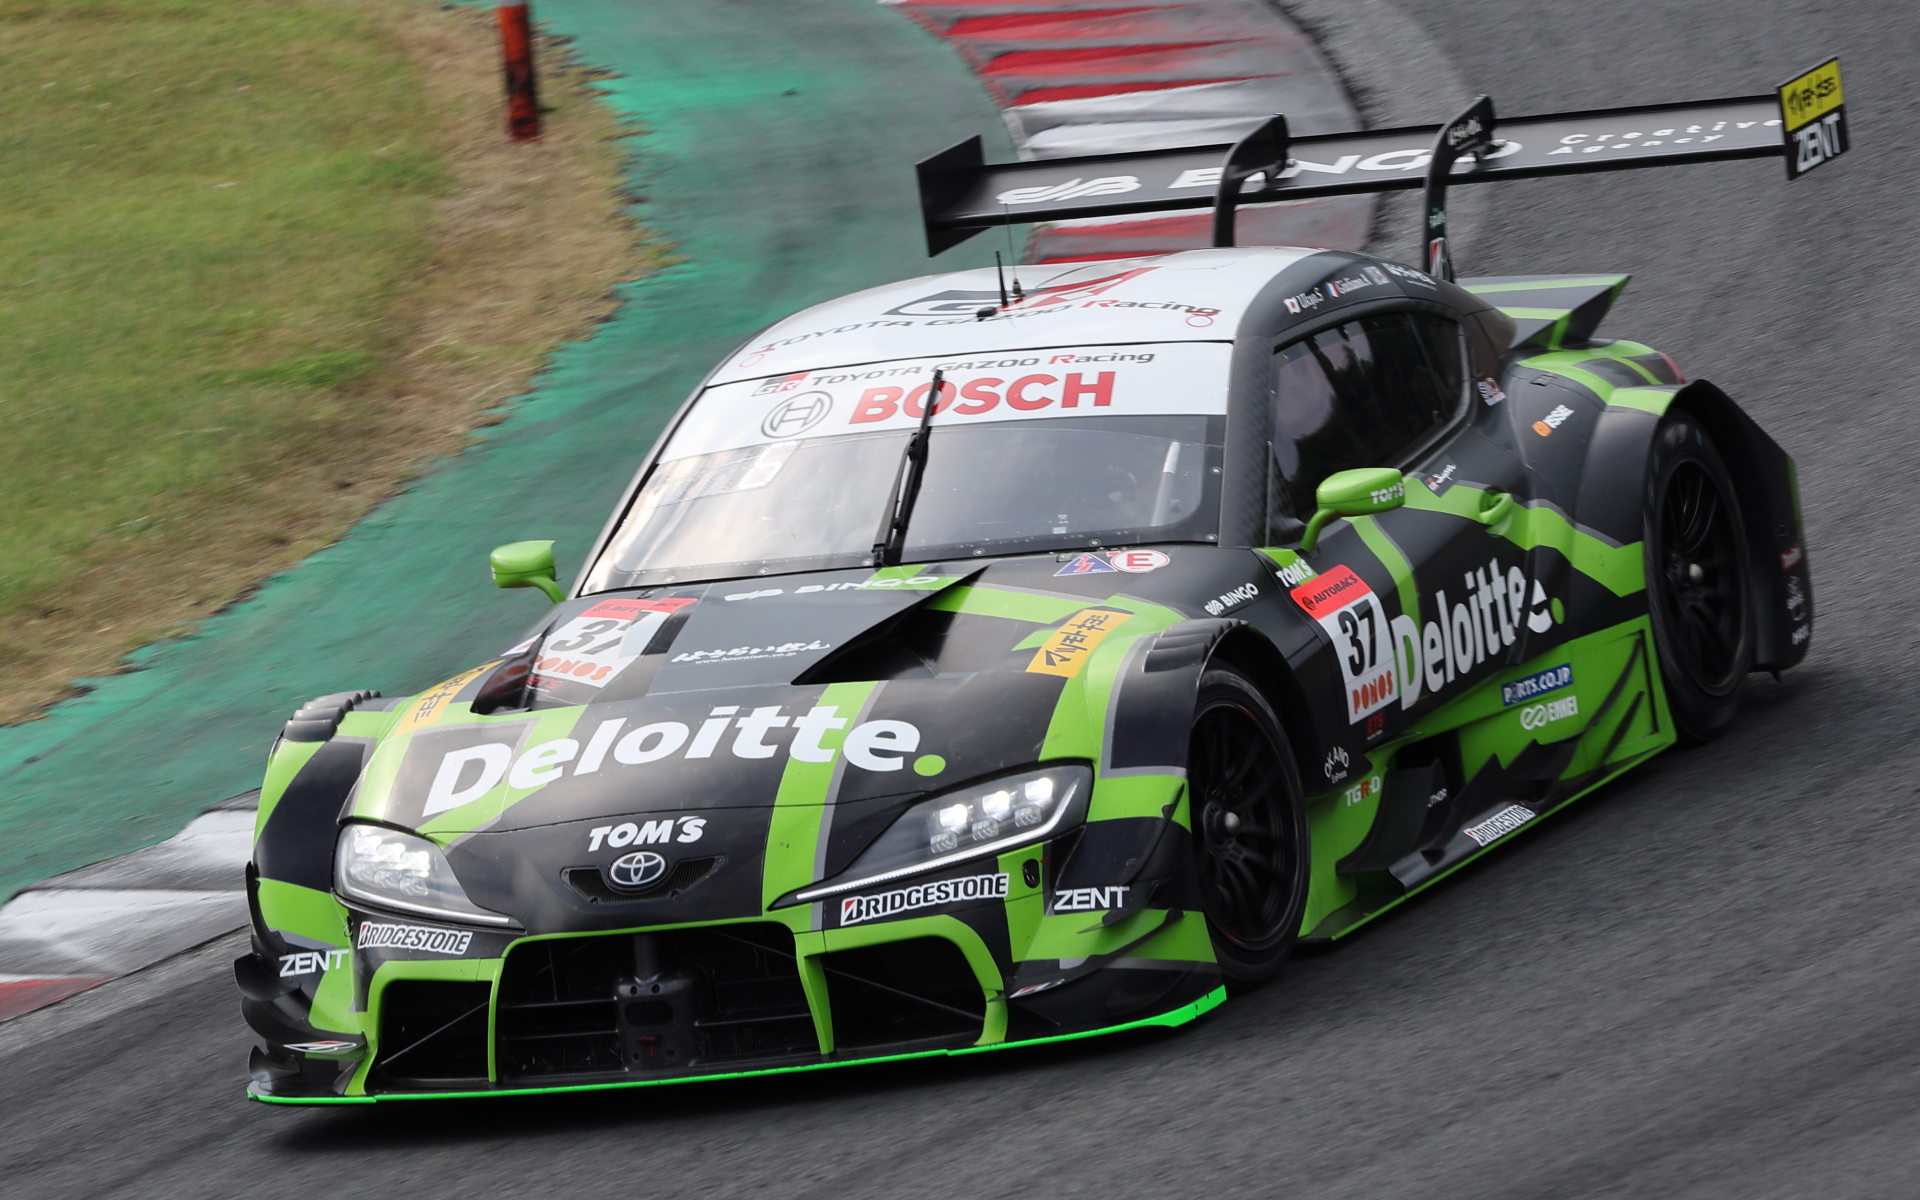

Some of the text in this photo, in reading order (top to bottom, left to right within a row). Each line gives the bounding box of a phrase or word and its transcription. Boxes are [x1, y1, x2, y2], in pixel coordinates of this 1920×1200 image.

[1547, 134, 1724, 156] Agency
[1560, 119, 1783, 144] Creative
[1793, 112, 1841, 173] ZENT
[760, 320, 914, 350] TOYOTA
[1081, 299, 1222, 317] Racing
[811, 352, 1156, 386] TOYOTA GAZOO Racing
[848, 371, 1116, 424] BOSCH
[1126, 552, 1155, 568] E
[1275, 558, 1314, 588] TOM'S
[795, 576, 939, 594] BINGO
[1219, 582, 1260, 607] BINGO
[1313, 574, 1358, 604] AUTOBACS
[1338, 598, 1377, 677] 37
[1352, 669, 1393, 715] PONOS
[1345, 776, 1381, 807] TGR-D
[588, 816, 708, 853] TOM'S
[1463, 805, 1536, 847] BRIDGESTONE
[841, 874, 1010, 926] BRIDGESTONE
[1054, 885, 1131, 911] ZENT
[358, 921, 473, 955] BRIDGESTONE
[279, 949, 350, 978] ZENT
